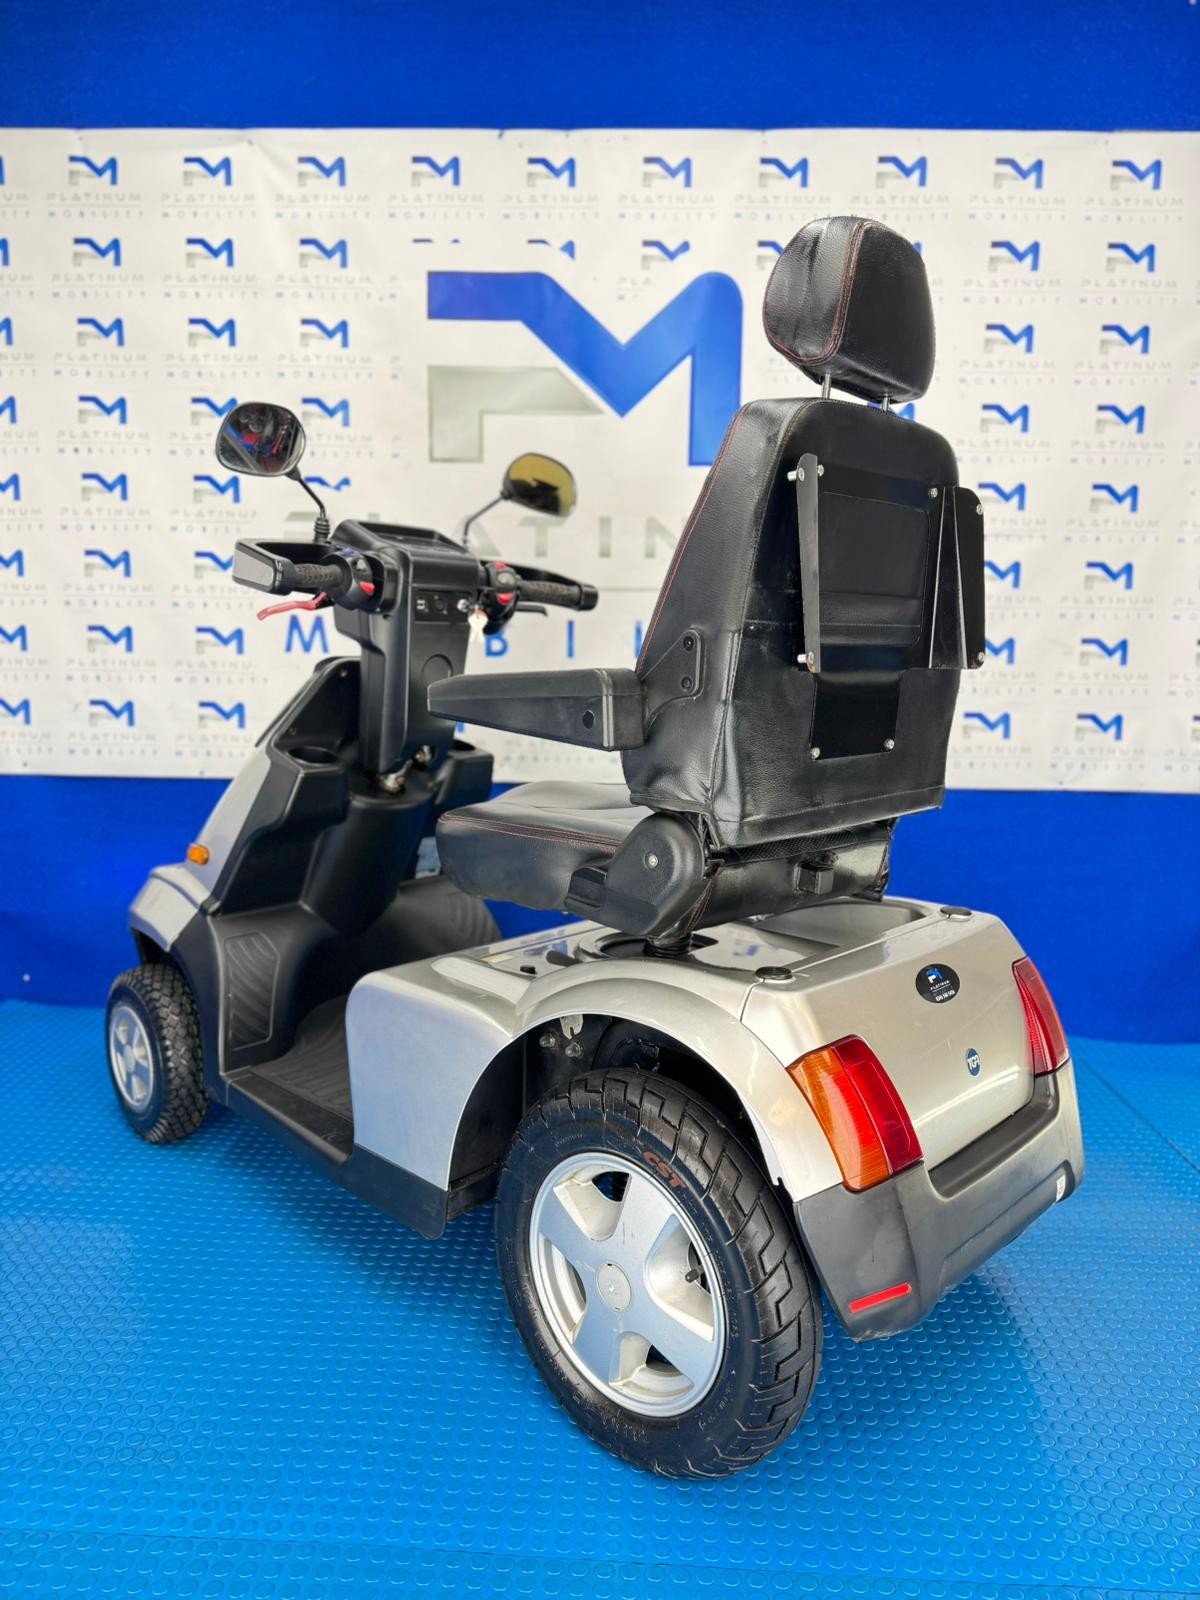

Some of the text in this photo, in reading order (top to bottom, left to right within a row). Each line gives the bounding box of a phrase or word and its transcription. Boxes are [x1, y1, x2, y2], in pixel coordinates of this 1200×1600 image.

[47, 193, 142, 202] PLATINUM
[160, 193, 256, 202] PLATINUM
[274, 193, 371, 202] PLATINUM
[388, 194, 484, 203] PLATINUM
[503, 194, 599, 203] PLATINUM
[618, 194, 715, 203] PLATINUM
[734, 194, 832, 204] PLATINUM
[850, 195, 950, 204] PLATINUM
[968, 195, 1065, 205] PLATINUM
[1085, 197, 1184, 207] PLATINUM
[52, 274, 144, 282] PLATINUM
[163, 274, 257, 283] PLATINUM
[274, 274, 372, 284] PLATINUM
[962, 278, 1062, 288] PLATINUM
[1081, 278, 1178, 288] PLATINUM
[54, 352, 148, 361] PLATINUM
[165, 353, 259, 362] PLATINUM
[277, 354, 372, 363] PLATINUM
[959, 360, 1056, 369] PLATINUM
[1074, 360, 1172, 370] PLATINUM
[57, 430, 150, 440] PLATINUM
[956, 439, 1052, 449] PLATINUM
[1071, 440, 1166, 450] PLATINUM
[60, 507, 151, 516] PLATINUM
[991, 517, 1048, 527] TINUM
[1065, 519, 1160, 528] PLATINUM
[63, 583, 155, 593] PLATINUM
[1060, 596, 1155, 605] PLATINUM
[66, 658, 155, 667] PLATINUM
[174, 660, 255, 669] PLATINU
[967, 671, 1036, 680] ATINUM
[1055, 671, 1150, 681] PLATINUM
[68, 732, 157, 741] PLATINUM
[176, 733, 253, 743] PLATINU
[953, 745, 1032, 755] LATINUM
[1050, 747, 1145, 756] PLATINUM
[643, 1151, 688, 1188] CST
